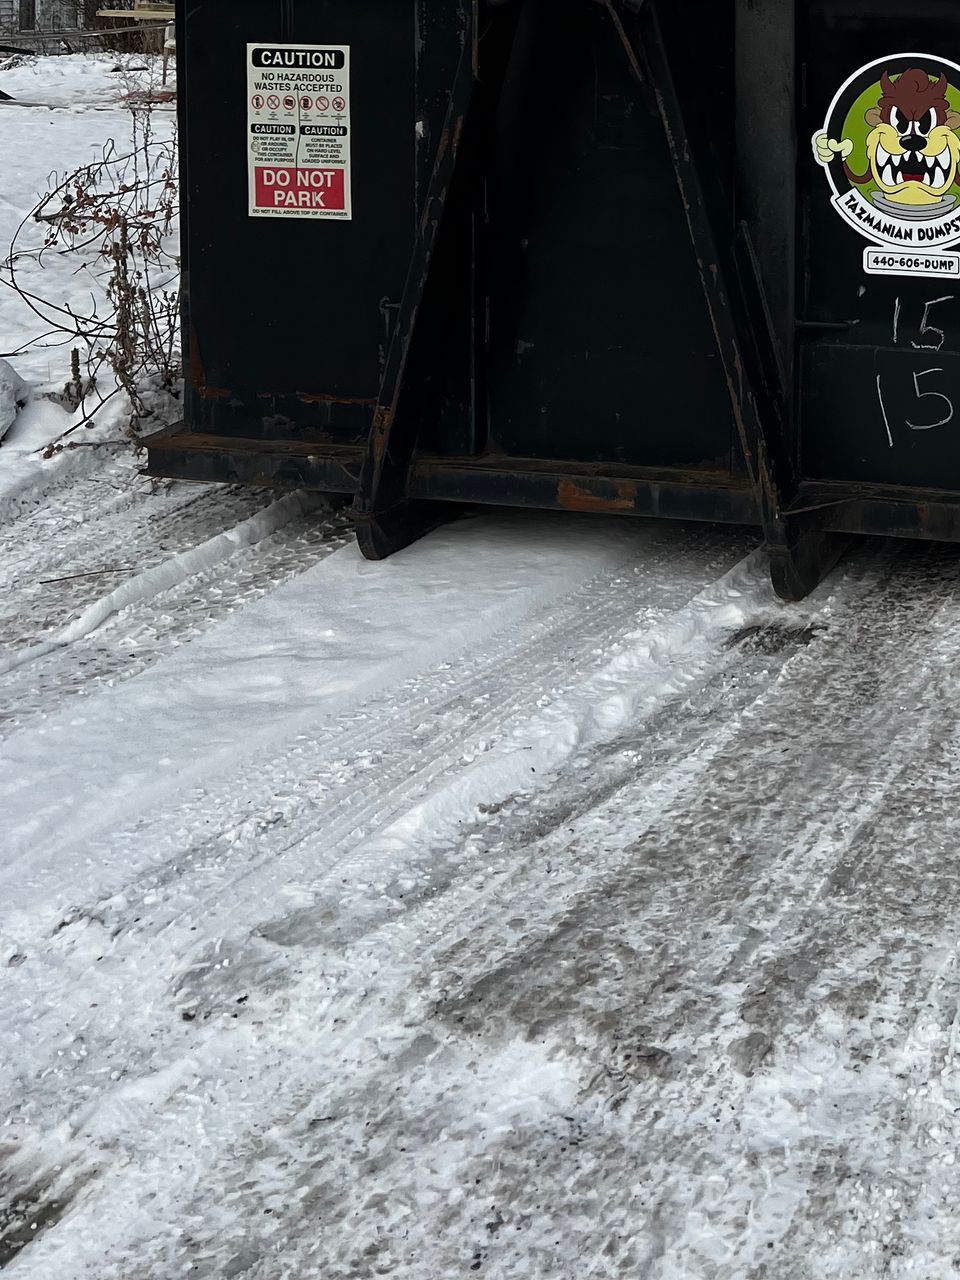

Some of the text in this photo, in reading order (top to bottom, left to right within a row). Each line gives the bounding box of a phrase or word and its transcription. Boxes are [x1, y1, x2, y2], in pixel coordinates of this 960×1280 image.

[261, 51, 335, 66] CAUTION
[261, 72, 335, 82] NO HAZARDOUS
[254, 82, 343, 92] WASTES ACCEPTED
[254, 124, 292, 134] CAUTION
[304, 126, 344, 135] CAUTION
[263, 169, 335, 188] DO NOT
[273, 190, 325, 207] PARK
[844, 195, 913, 241] TAZMANIAN
[872, 257, 955, 270] 440-606-DUMP
